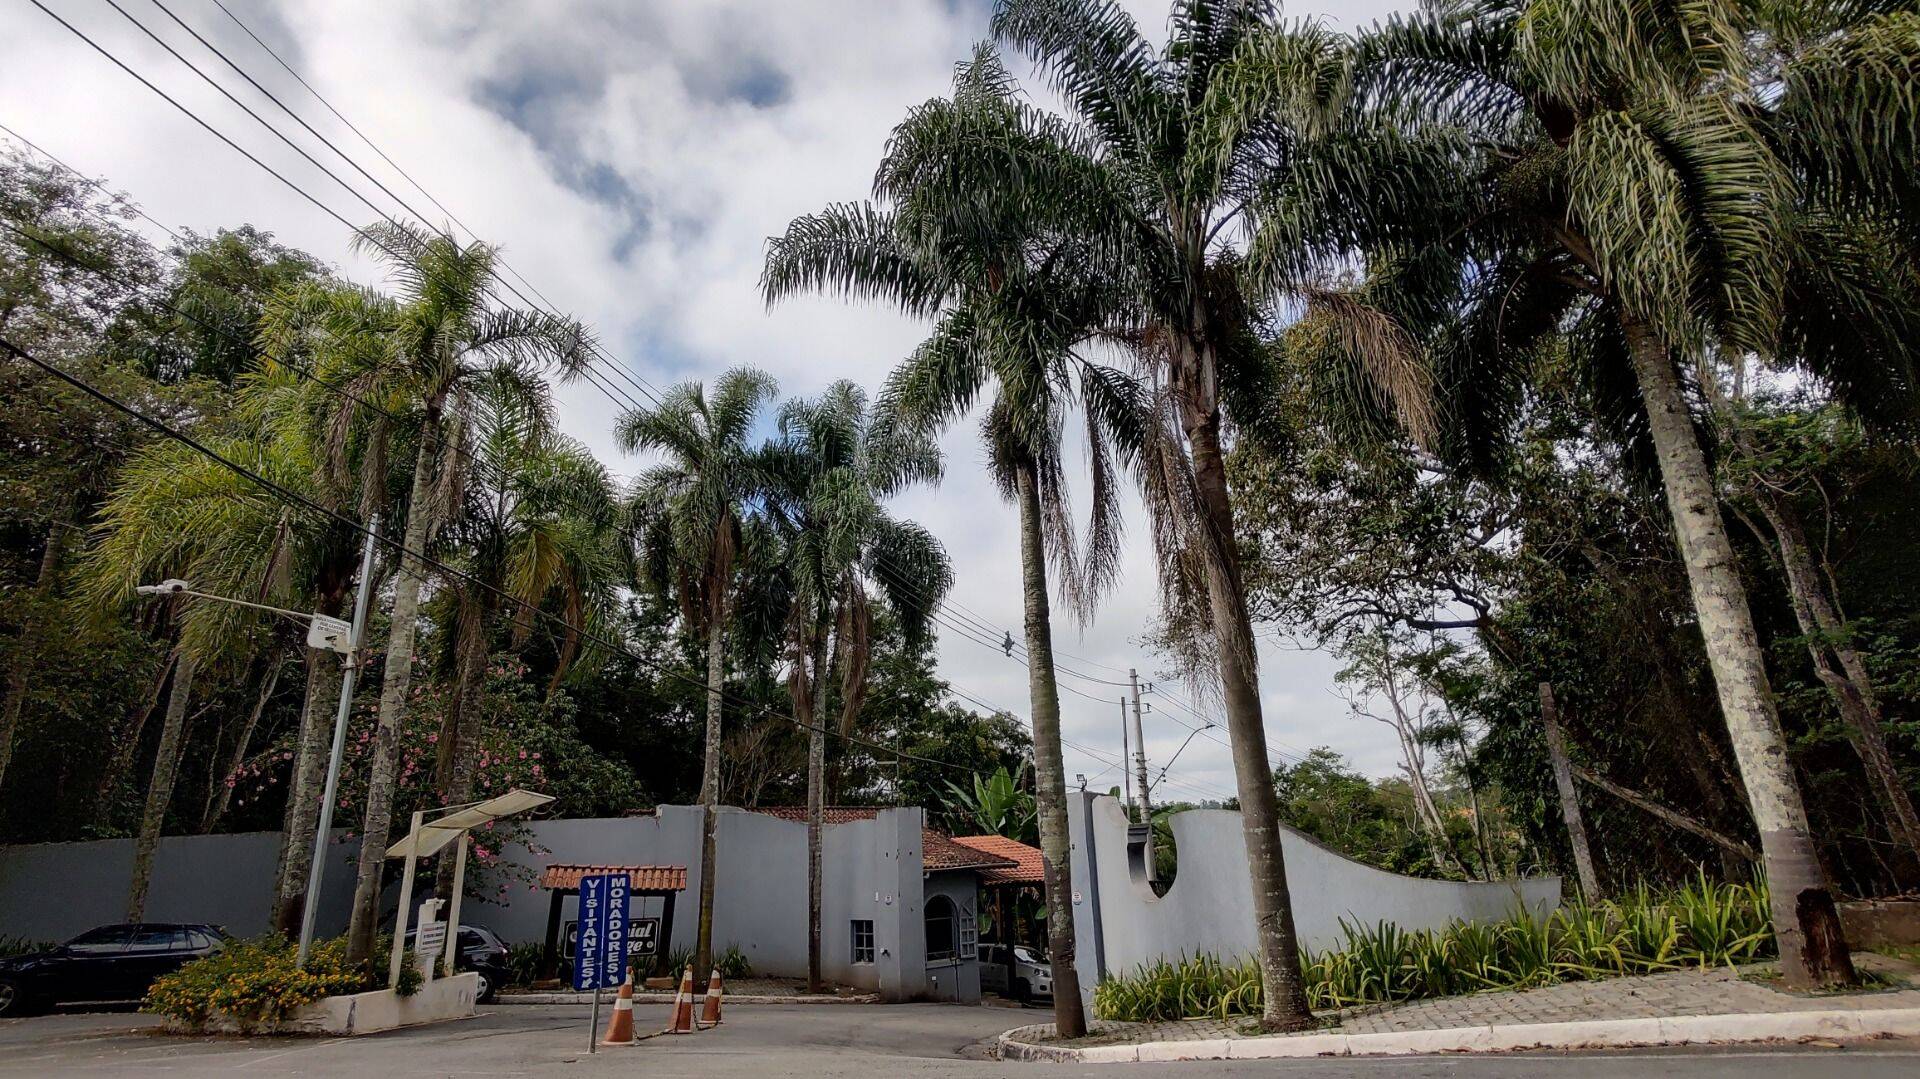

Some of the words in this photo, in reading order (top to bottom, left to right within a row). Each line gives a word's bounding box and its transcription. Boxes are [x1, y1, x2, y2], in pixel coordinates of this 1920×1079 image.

[581, 879, 600, 978] VISITANTES
[607, 877, 626, 974] MORADORES
[627, 922, 653, 938] ial
[627, 940, 644, 955] ge
